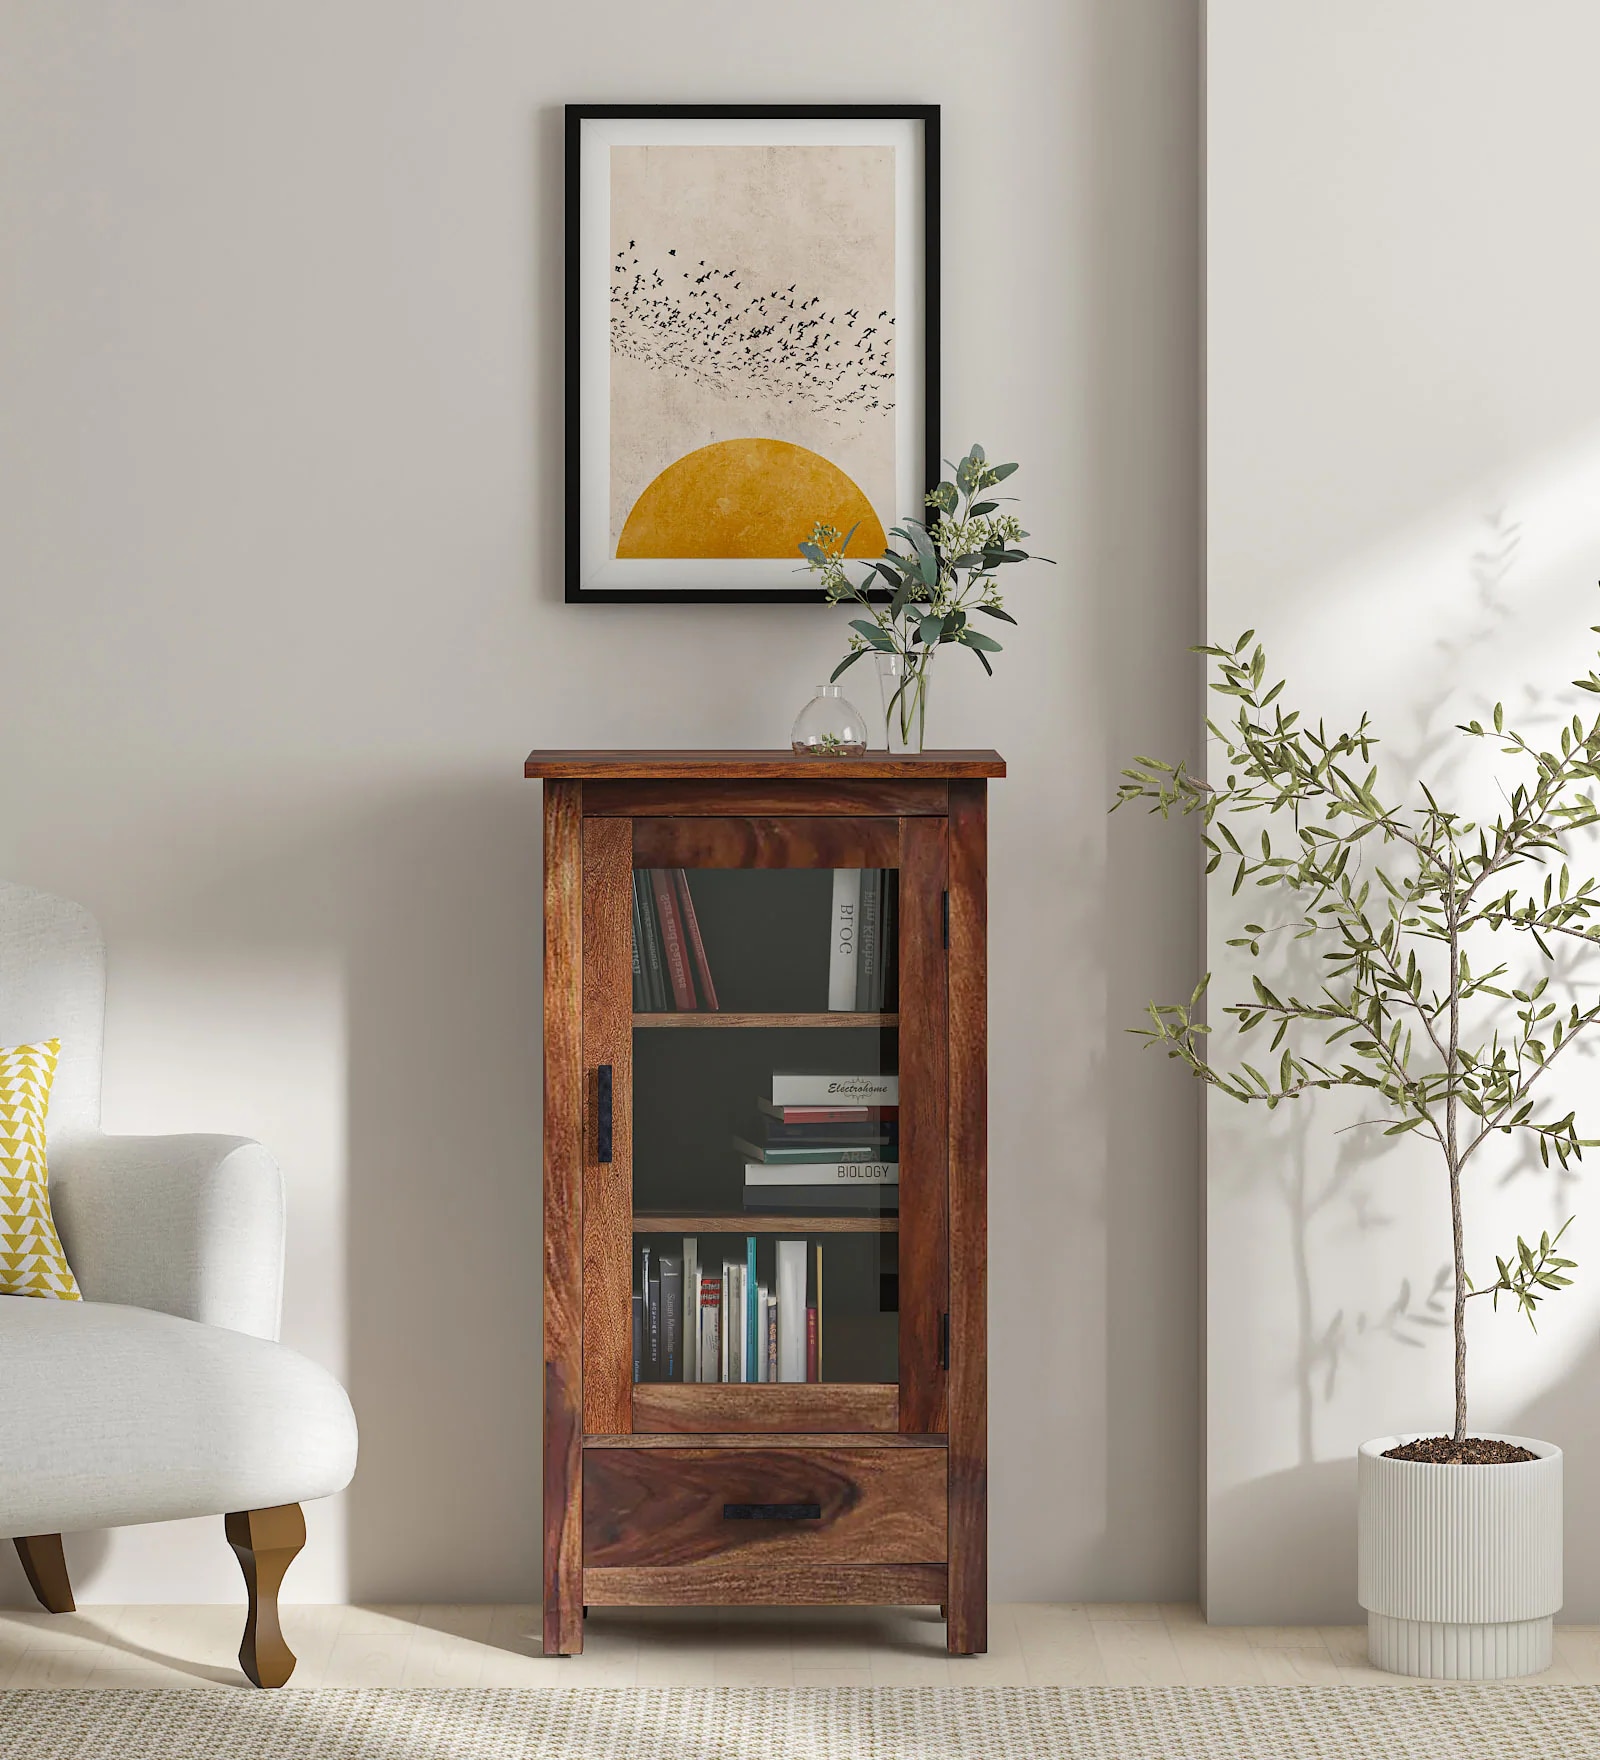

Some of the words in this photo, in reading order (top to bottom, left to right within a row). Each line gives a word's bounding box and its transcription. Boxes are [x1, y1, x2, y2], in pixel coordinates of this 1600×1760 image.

[827, 1082, 888, 1094] Electrohome
[841, 1151, 879, 1162] AREA
[837, 1165, 889, 1178] BIOLOGY
